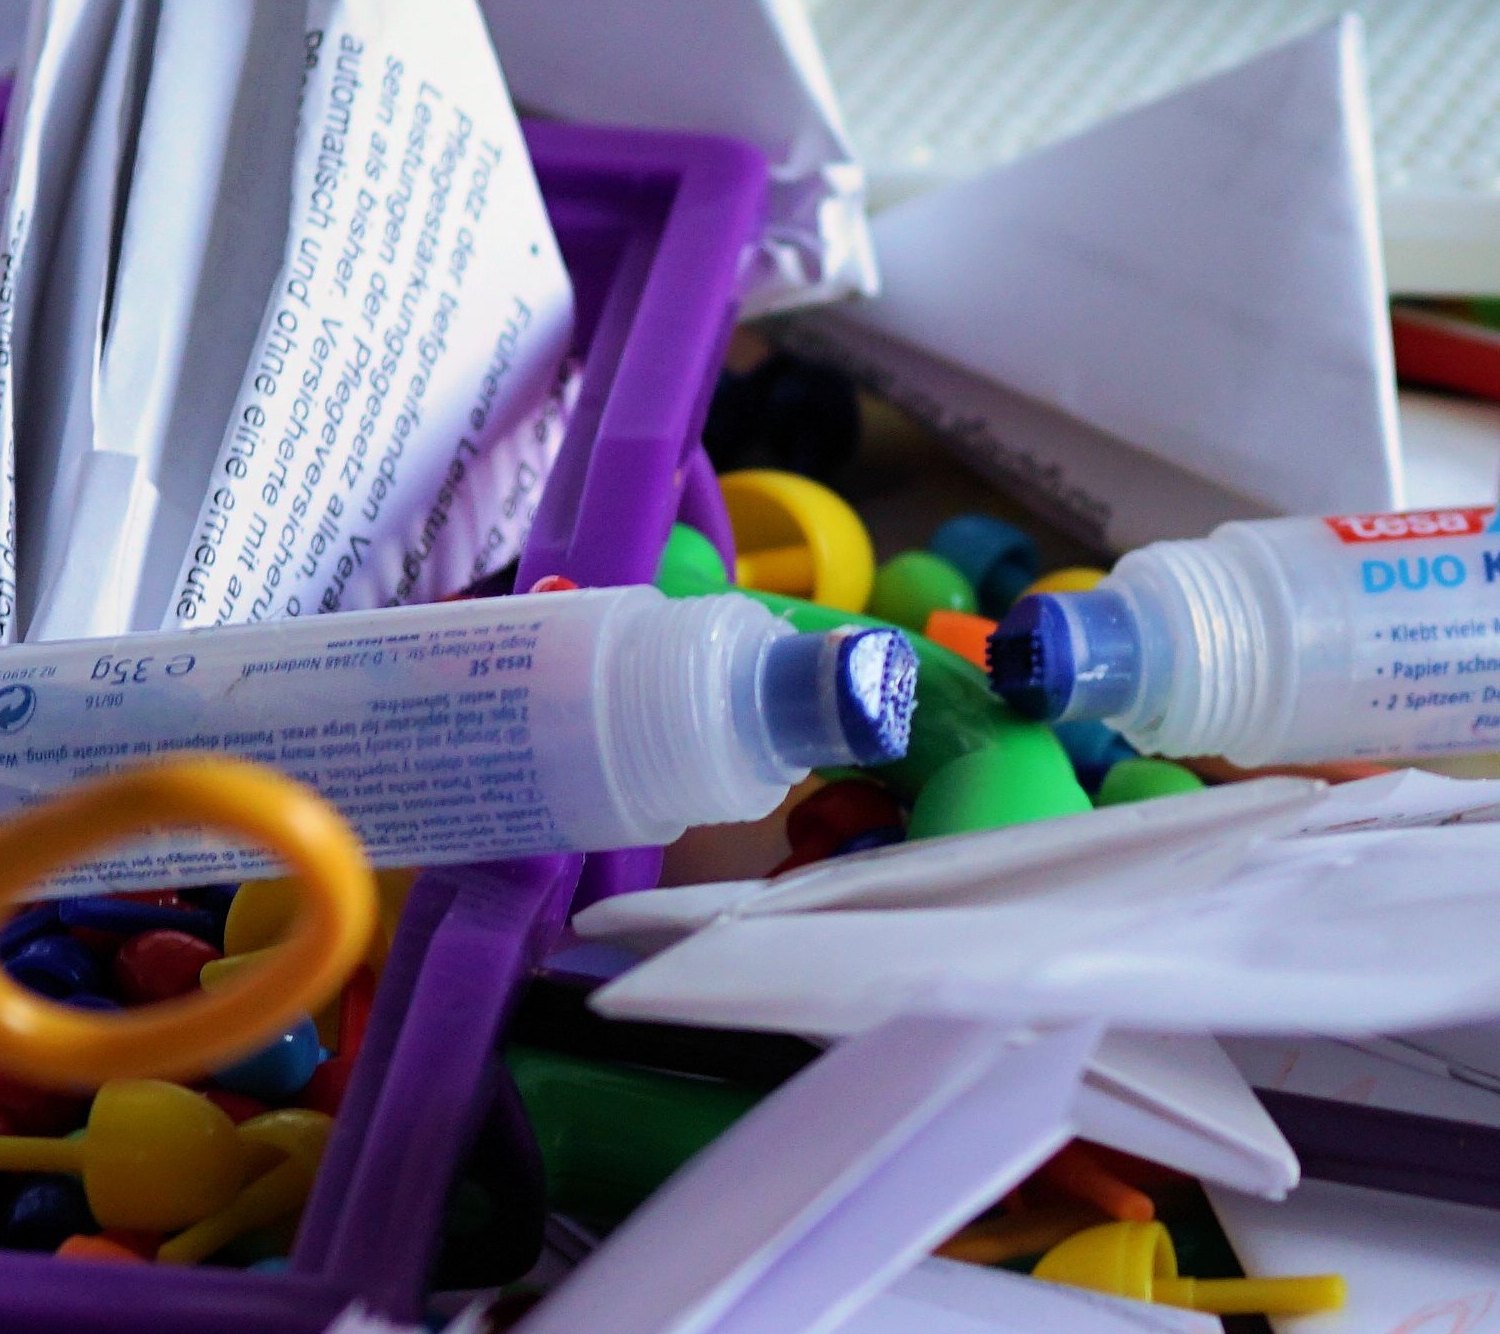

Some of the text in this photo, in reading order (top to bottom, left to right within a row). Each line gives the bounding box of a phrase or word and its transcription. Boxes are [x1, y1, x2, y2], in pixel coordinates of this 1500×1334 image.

[376, 54, 405, 126] sein
[364, 131, 388, 182] als
[380, 81, 442, 264] Leistungen
[466, 141, 502, 221] Trotz
[329, 188, 377, 298] bisher.
[450, 227, 475, 286] der
[176, 33, 363, 620] automatisch und ohne eine erneute
[361, 270, 388, 332] der
[261, 316, 343, 506] Versicherte
[239, 512, 268, 573] mit
[1336, 513, 1467, 537] tesa
[1360, 554, 1467, 595] DUO
[1390, 621, 1439, 645] Klebt
[1445, 617, 1490, 641] viele
[87, 651, 156, 687] 35g
[467, 654, 533, 677] tesa SE
[1390, 656, 1451, 686] Papier
[71, 742, 129, 762] accurate
